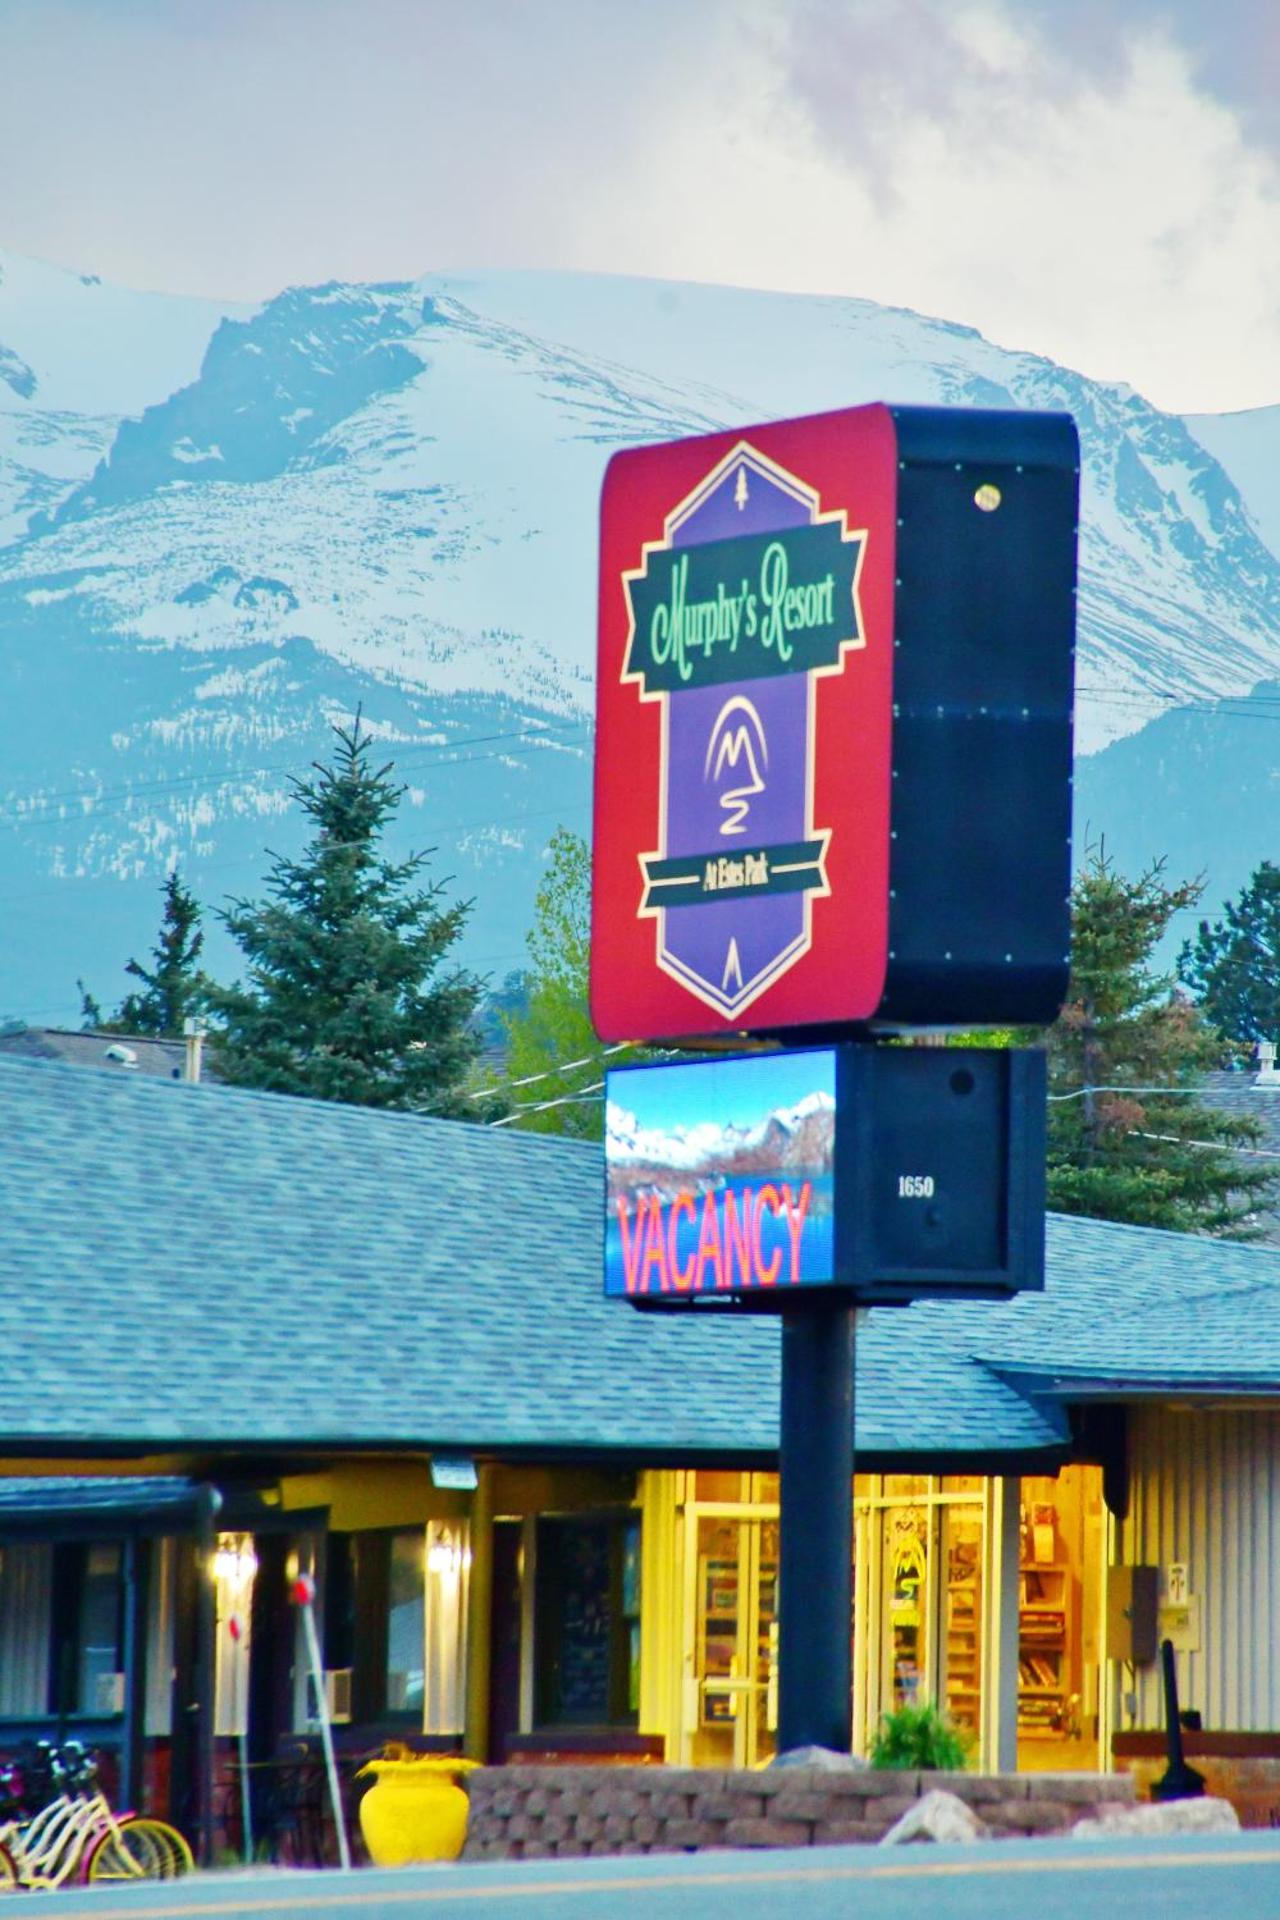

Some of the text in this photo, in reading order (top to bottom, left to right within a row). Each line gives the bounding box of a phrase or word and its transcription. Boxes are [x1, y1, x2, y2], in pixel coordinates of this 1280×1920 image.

[652, 542, 835, 680] Murphy's Resort
[617, 1180, 811, 1294] VACANCY
[899, 1175, 934, 1198] 1650
